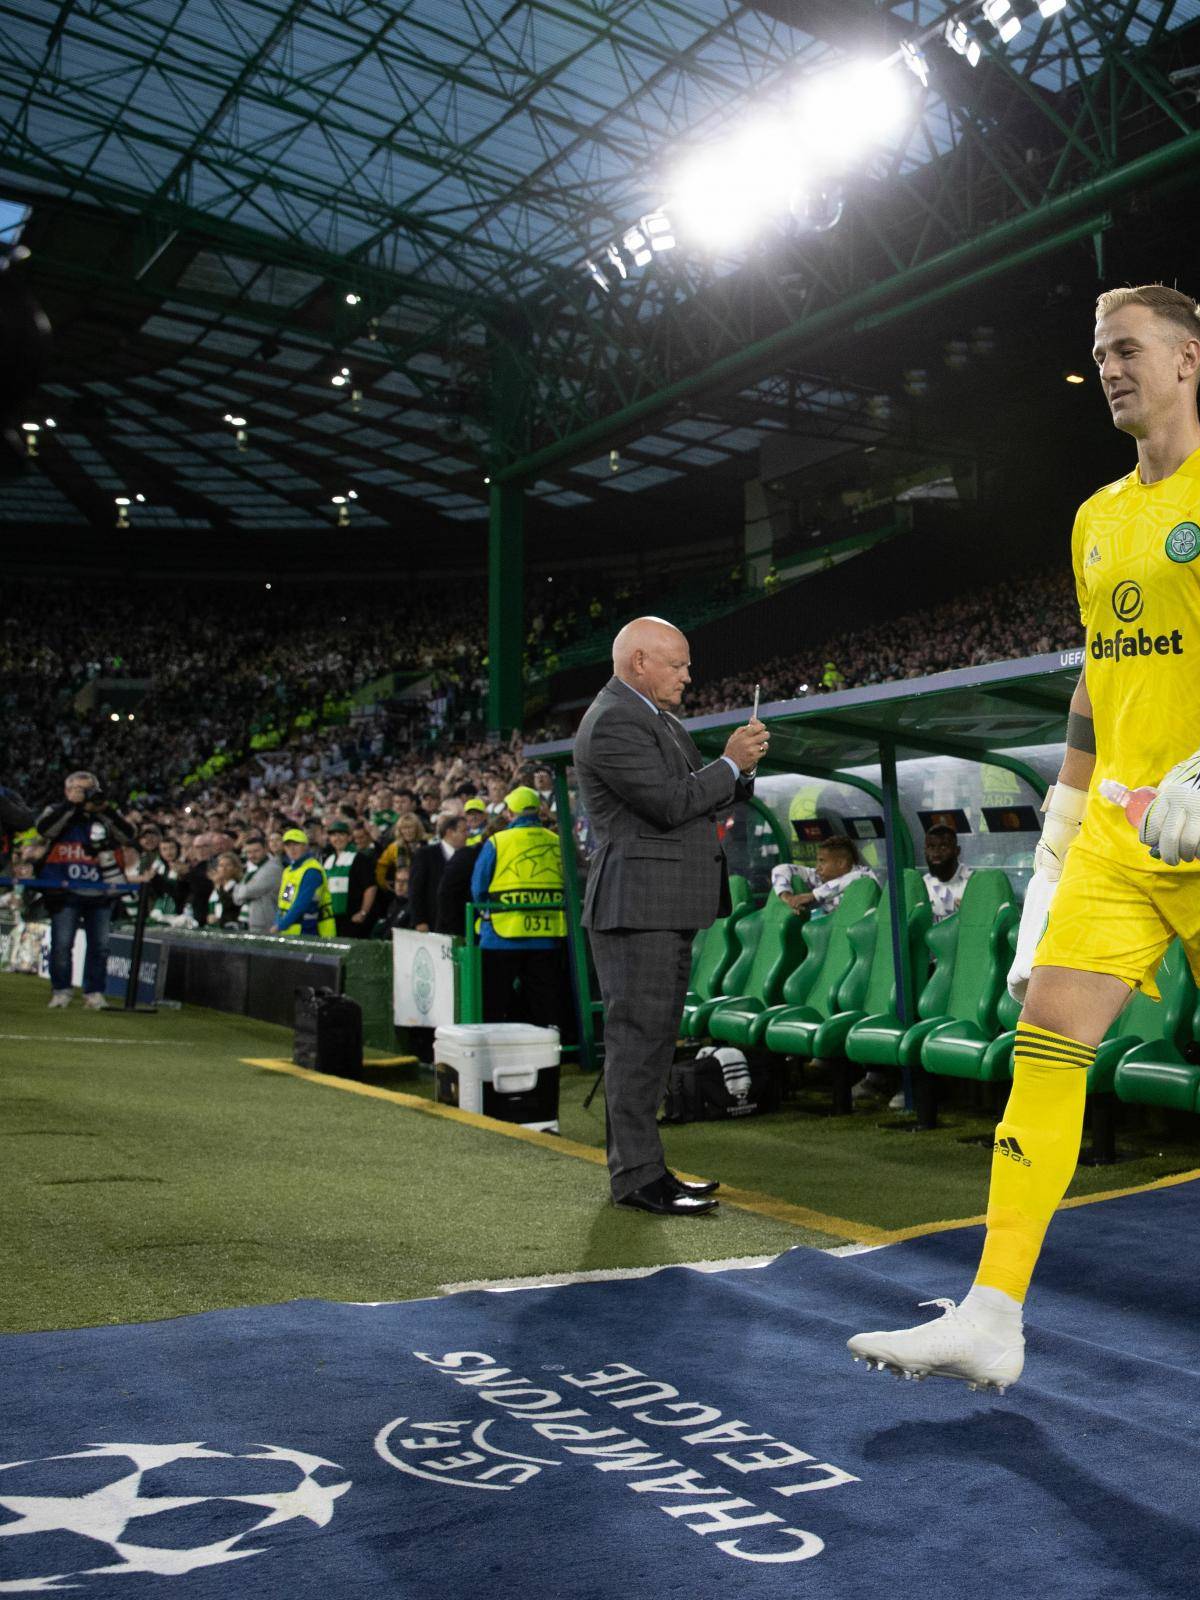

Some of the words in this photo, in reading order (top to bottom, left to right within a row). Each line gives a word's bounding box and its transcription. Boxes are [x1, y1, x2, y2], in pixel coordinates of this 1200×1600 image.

[1091, 628, 1183, 663] dafabet
[68, 864, 99, 882] 036
[500, 890, 563, 905] STEWAR
[523, 915, 553, 932] 031
[559, 1362, 863, 1497] LEAGUE
[399, 1419, 543, 1485] UEFA
[412, 1350, 826, 1563] CHAMPIONS
